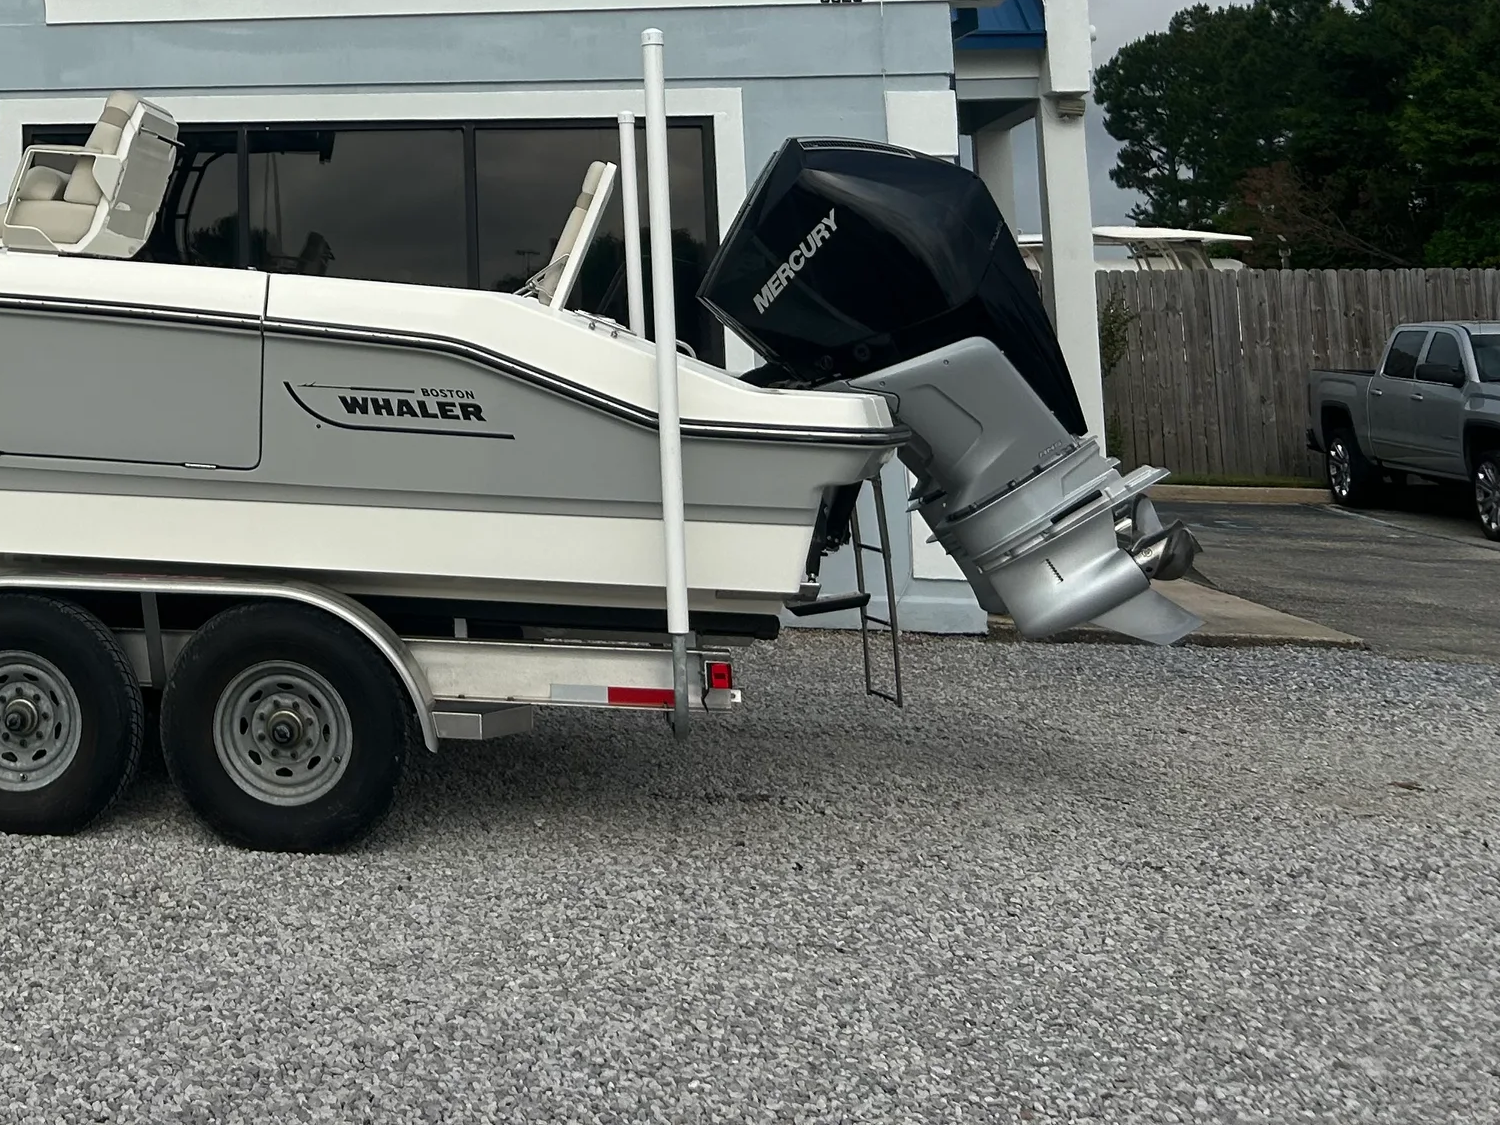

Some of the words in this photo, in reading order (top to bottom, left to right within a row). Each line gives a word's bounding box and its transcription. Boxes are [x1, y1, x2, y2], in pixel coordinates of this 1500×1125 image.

[752, 207, 838, 315] MERCURY
[420, 387, 475, 400] BOSTON
[338, 395, 487, 422] WHALER
